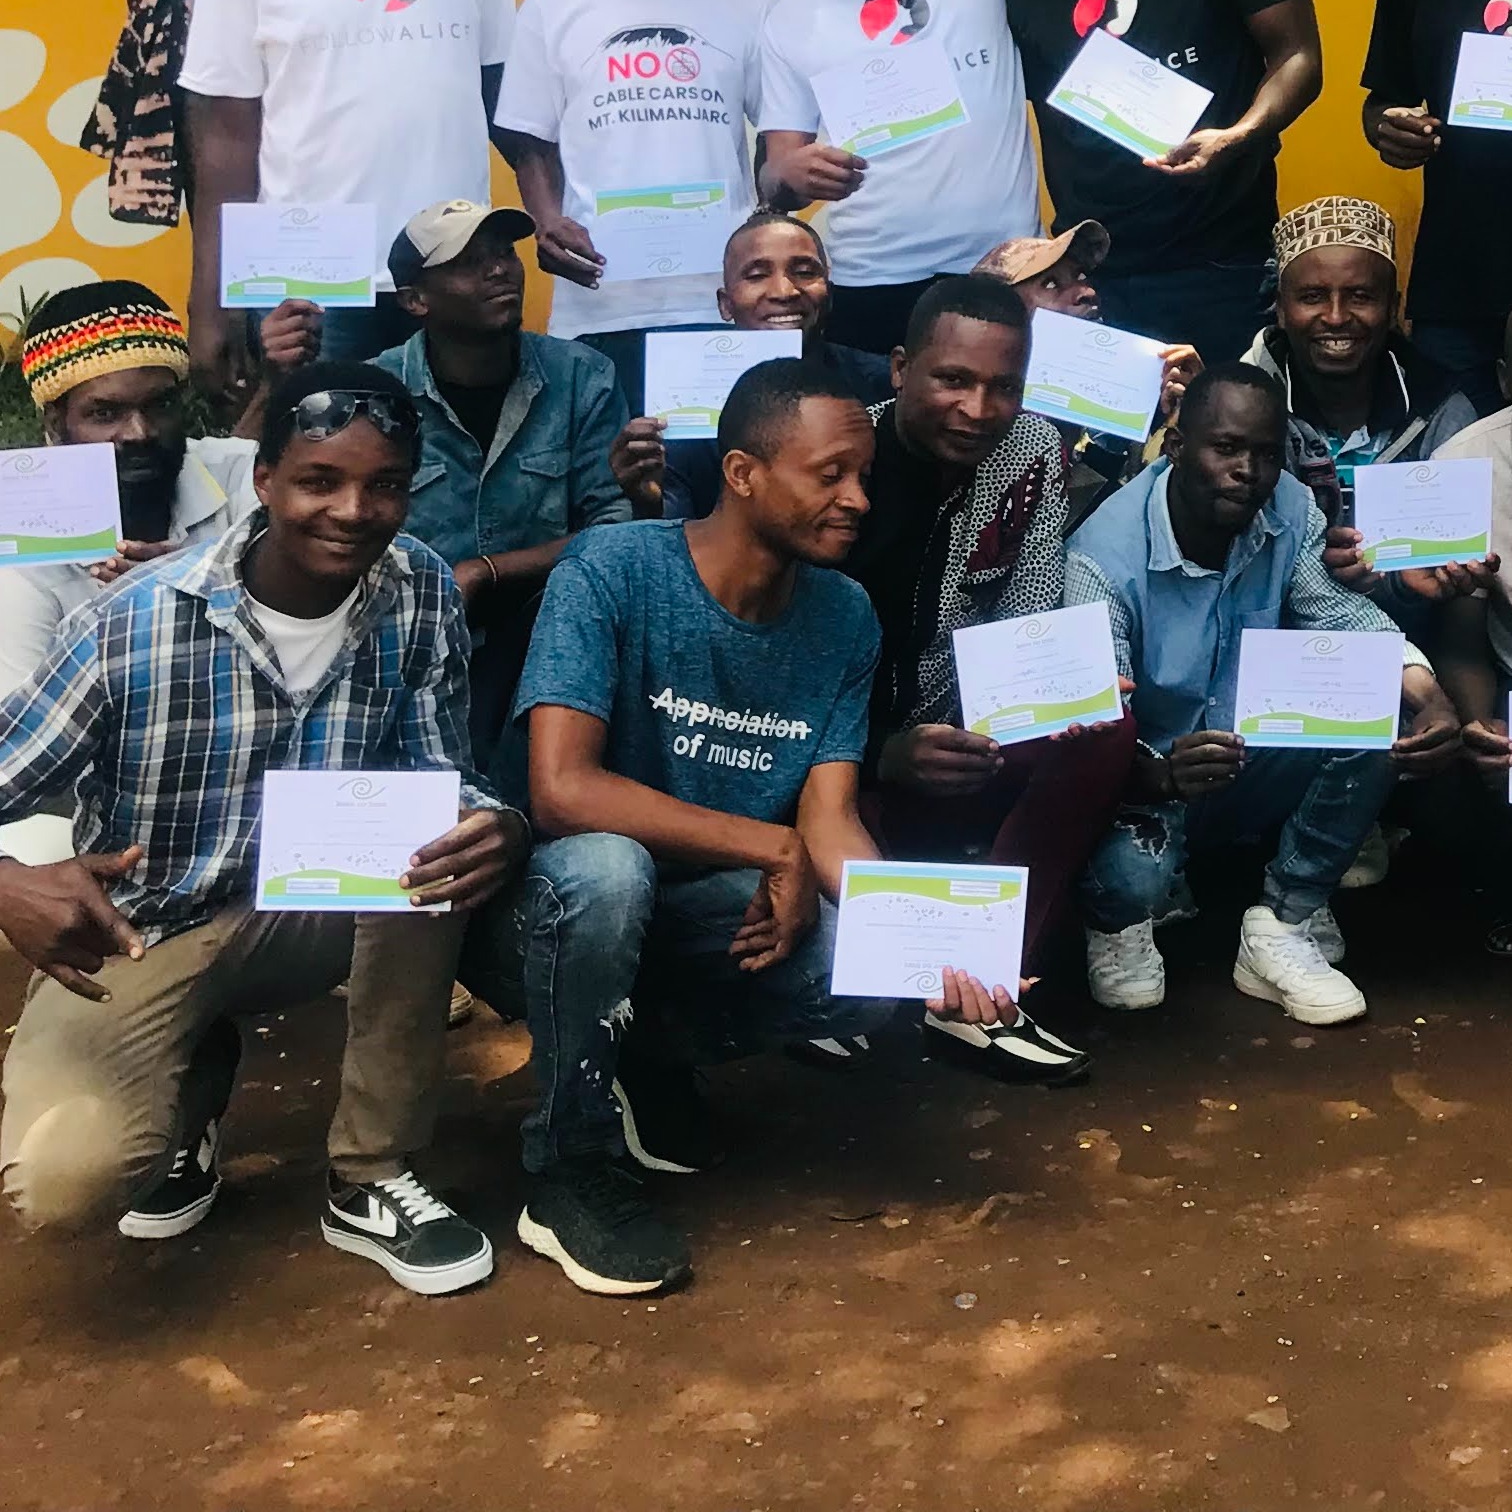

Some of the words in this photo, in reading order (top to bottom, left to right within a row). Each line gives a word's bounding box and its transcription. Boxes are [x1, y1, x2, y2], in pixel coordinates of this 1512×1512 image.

[608, 51, 661, 83] NO
[593, 87, 646, 108] CABLE
[649, 86, 699, 101] CARS
[701, 88, 726, 104] ON
[588, 112, 617, 131] MT.
[618, 106, 731, 126] KILIMANJARO
[673, 734, 706, 759] of
[707, 742, 774, 772] music
